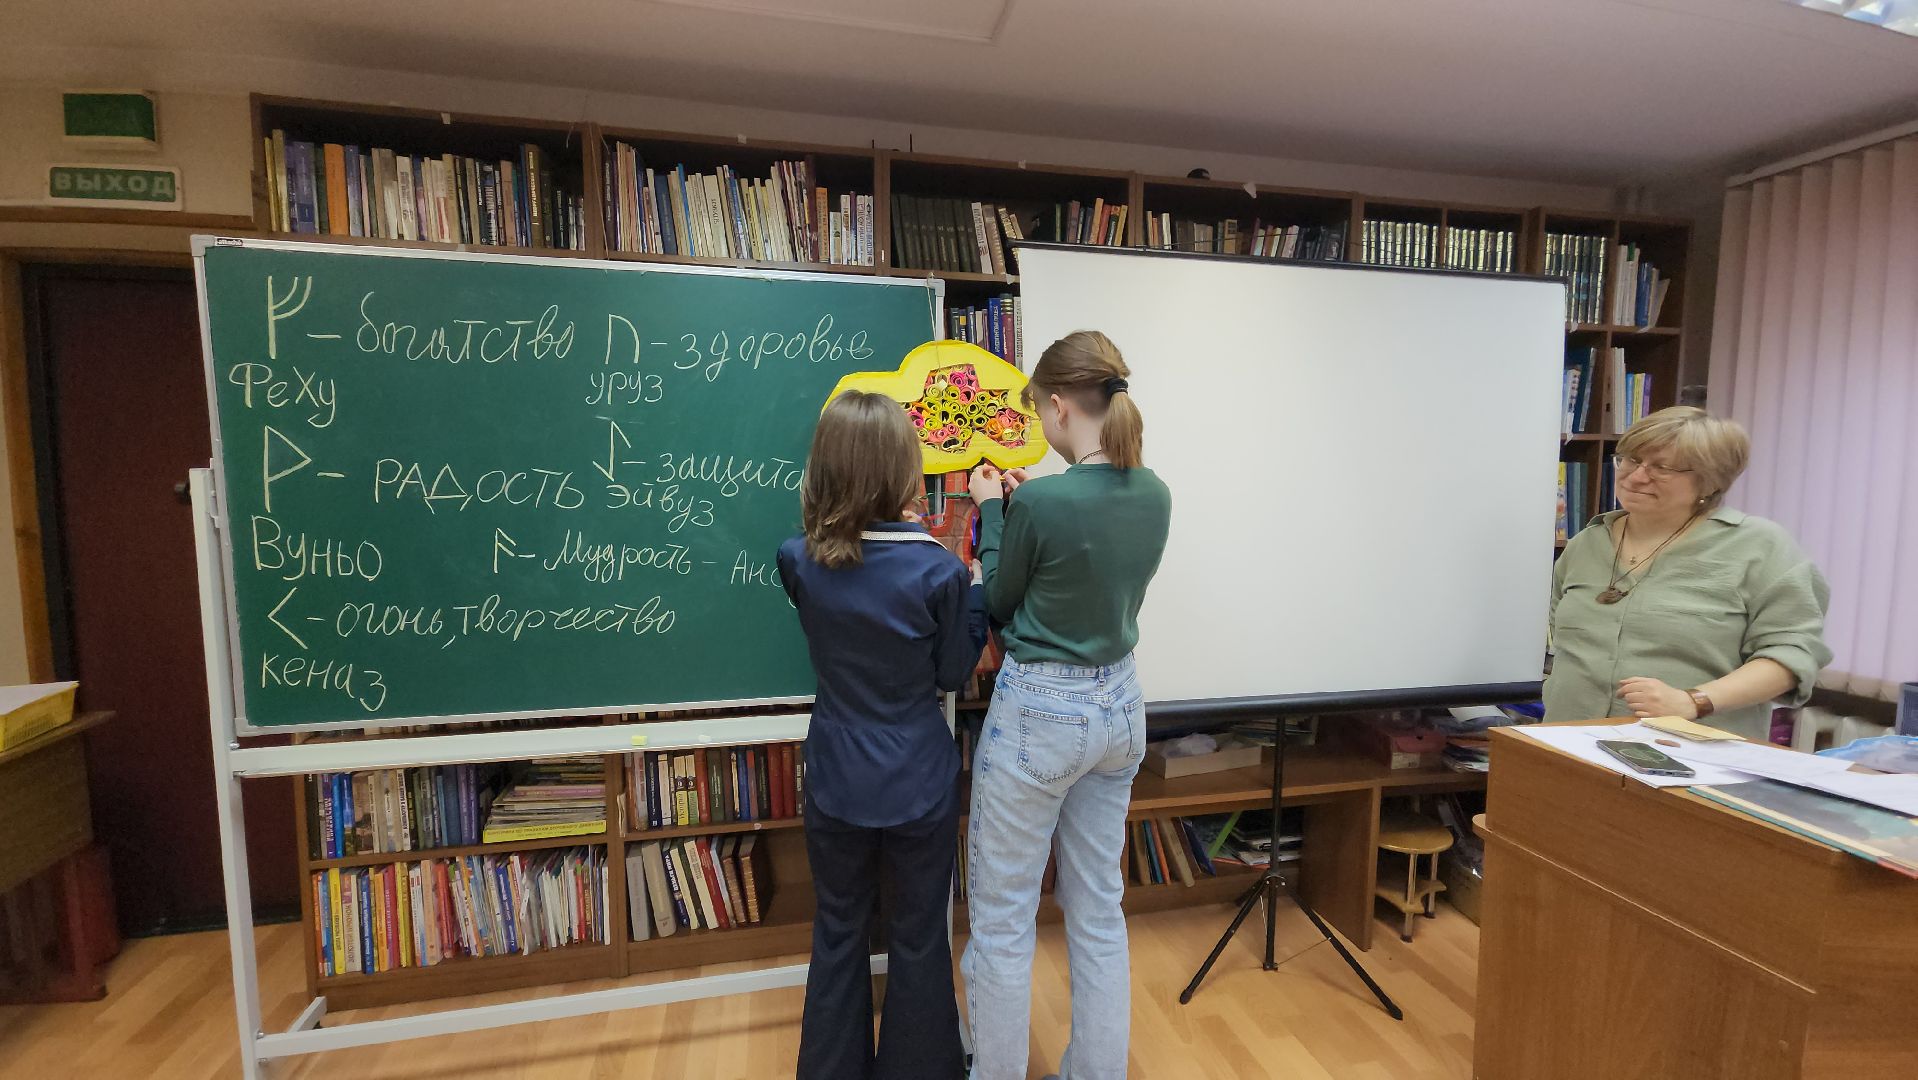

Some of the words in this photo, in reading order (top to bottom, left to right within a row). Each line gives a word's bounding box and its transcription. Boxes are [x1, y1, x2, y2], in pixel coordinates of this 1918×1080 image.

[55, 172, 174, 198] ВЫХОД
[356, 291, 574, 363] богатство
[674, 313, 874, 382] здоровье
[229, 362, 336, 428] Феху
[585, 370, 663, 405] уруз
[656, 452, 803, 497] защита
